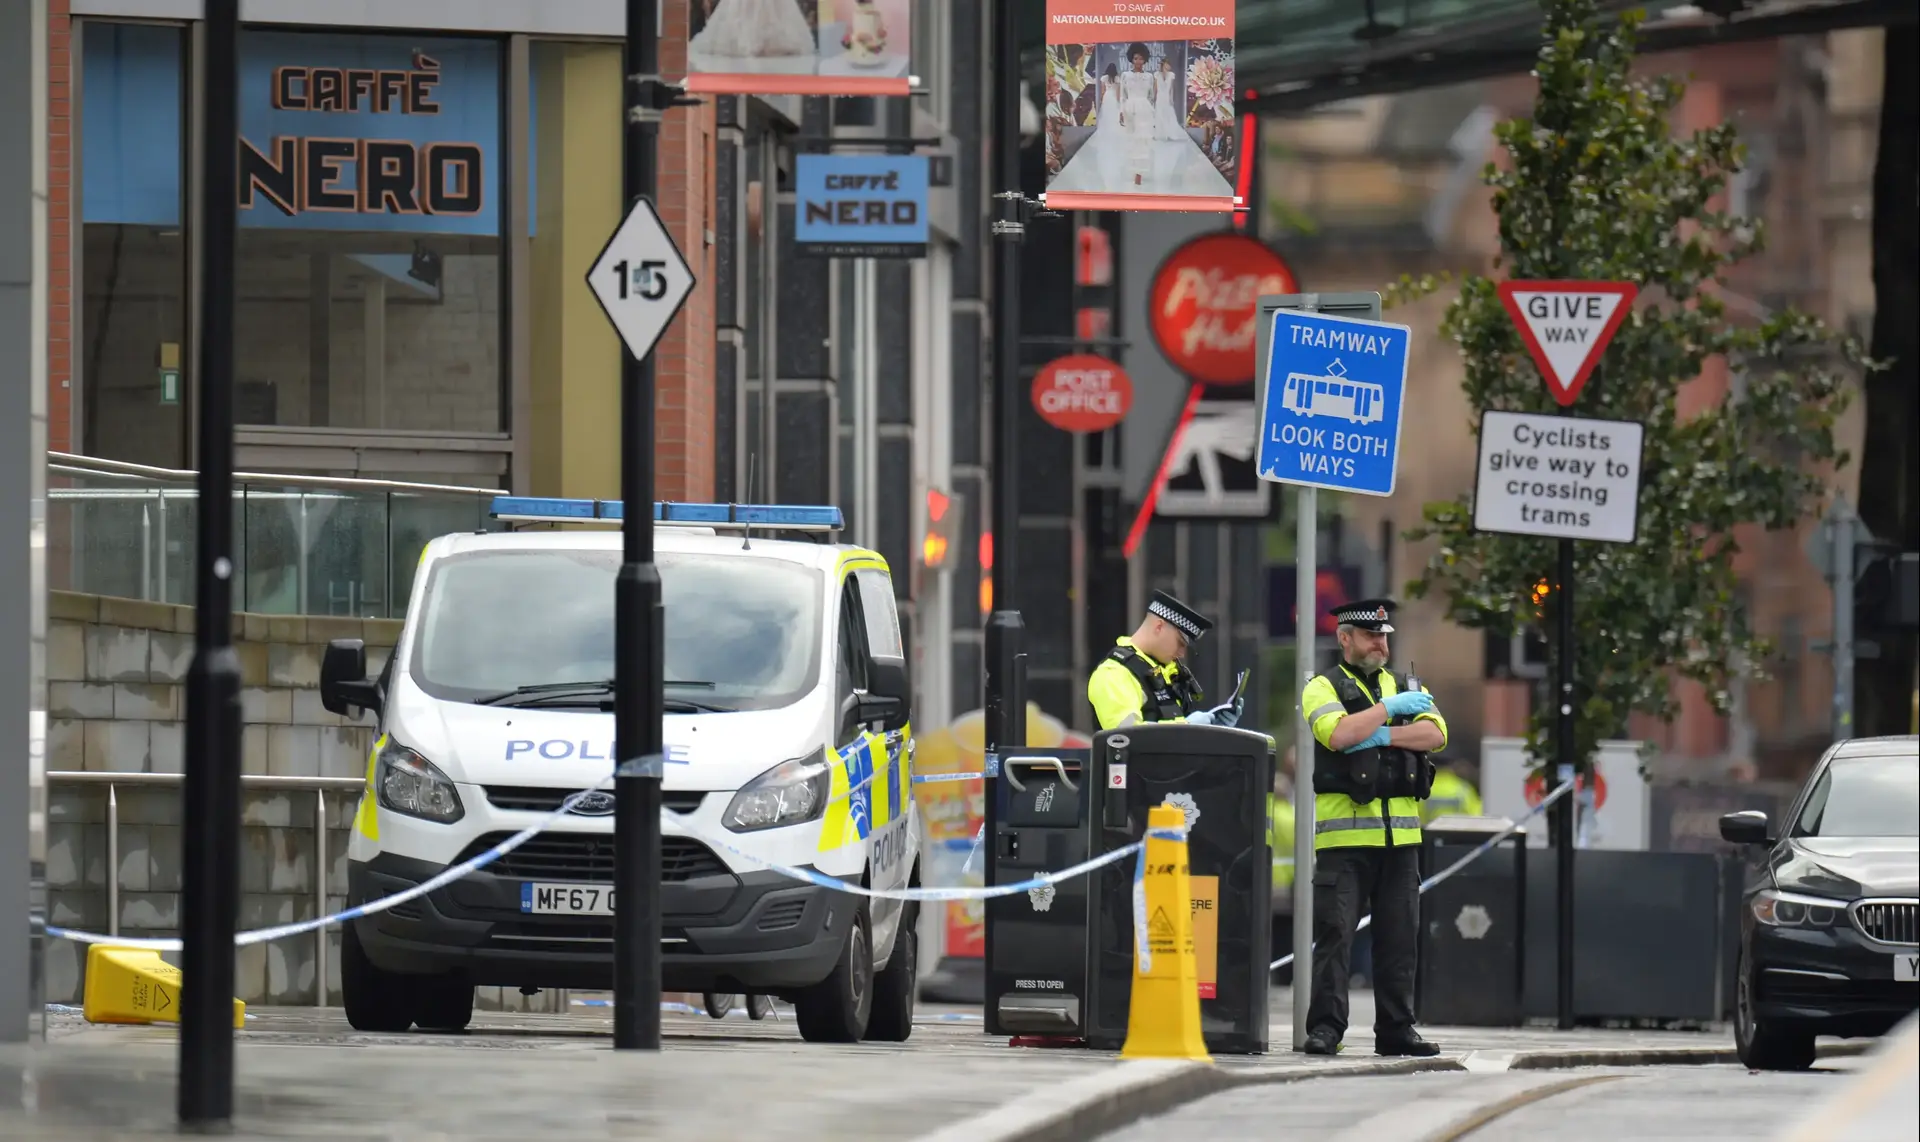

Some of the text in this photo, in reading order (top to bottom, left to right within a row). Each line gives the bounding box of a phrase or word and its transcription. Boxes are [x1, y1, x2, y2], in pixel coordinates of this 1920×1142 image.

[1053, 14, 1226, 26] NATIONALWEDDINGSHOW.CO.UK
[1113, 3, 1166, 12] TO SAVE AT
[271, 53, 441, 115] CAFFÈ
[238, 136, 483, 216] NERO
[806, 201, 917, 225] NERO
[613, 260, 667, 301] 15
[1528, 296, 1603, 319] GIVE
[1290, 325, 1391, 356] TRAMWAY
[1545, 327, 1588, 343] WAY
[1055, 369, 1112, 389] POST
[1040, 391, 1121, 414] OFFICE
[1271, 423, 1388, 457] LOOK BOTH
[1513, 423, 1612, 450] Cyclists
[1299, 451, 1355, 478] WAYS
[1490, 450, 1630, 479] give way to
[1506, 479, 1608, 507] crossing
[1521, 504, 1591, 527] trams
[505, 739, 691, 765] POLIE
[537, 888, 600, 912] MF67
[1015, 979, 1064, 990] PRESS TO OPEN
